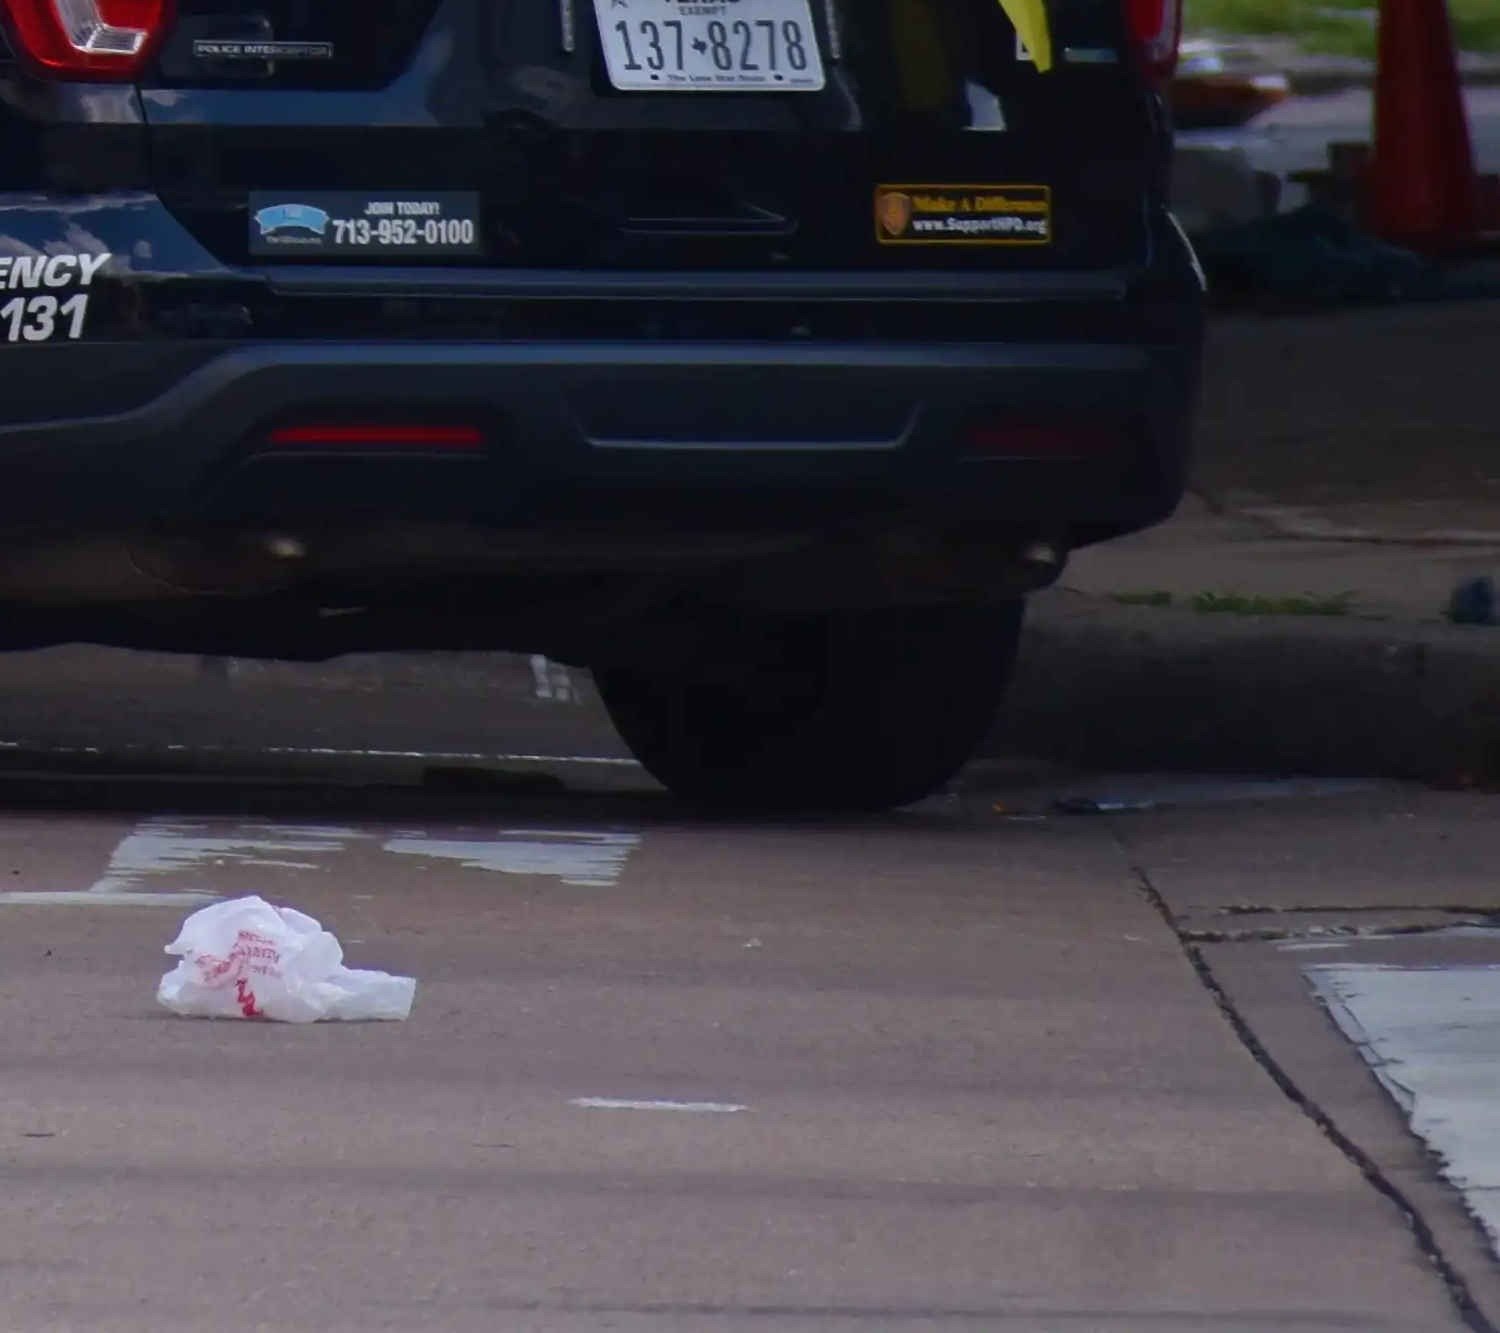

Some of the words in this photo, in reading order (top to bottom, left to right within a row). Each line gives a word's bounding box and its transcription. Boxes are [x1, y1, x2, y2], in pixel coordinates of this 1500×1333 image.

[679, 5, 727, 17] EXEMPT
[196, 44, 241, 54] POLICE
[364, 201, 394, 214] JOIN
[397, 201, 440, 214] TODAY!
[912, 196, 956, 212] Make
[961, 197, 971, 212] A
[332, 219, 474, 245] 713-952-0100
[912, 217, 1047, 234] www.SupportHPD.org
